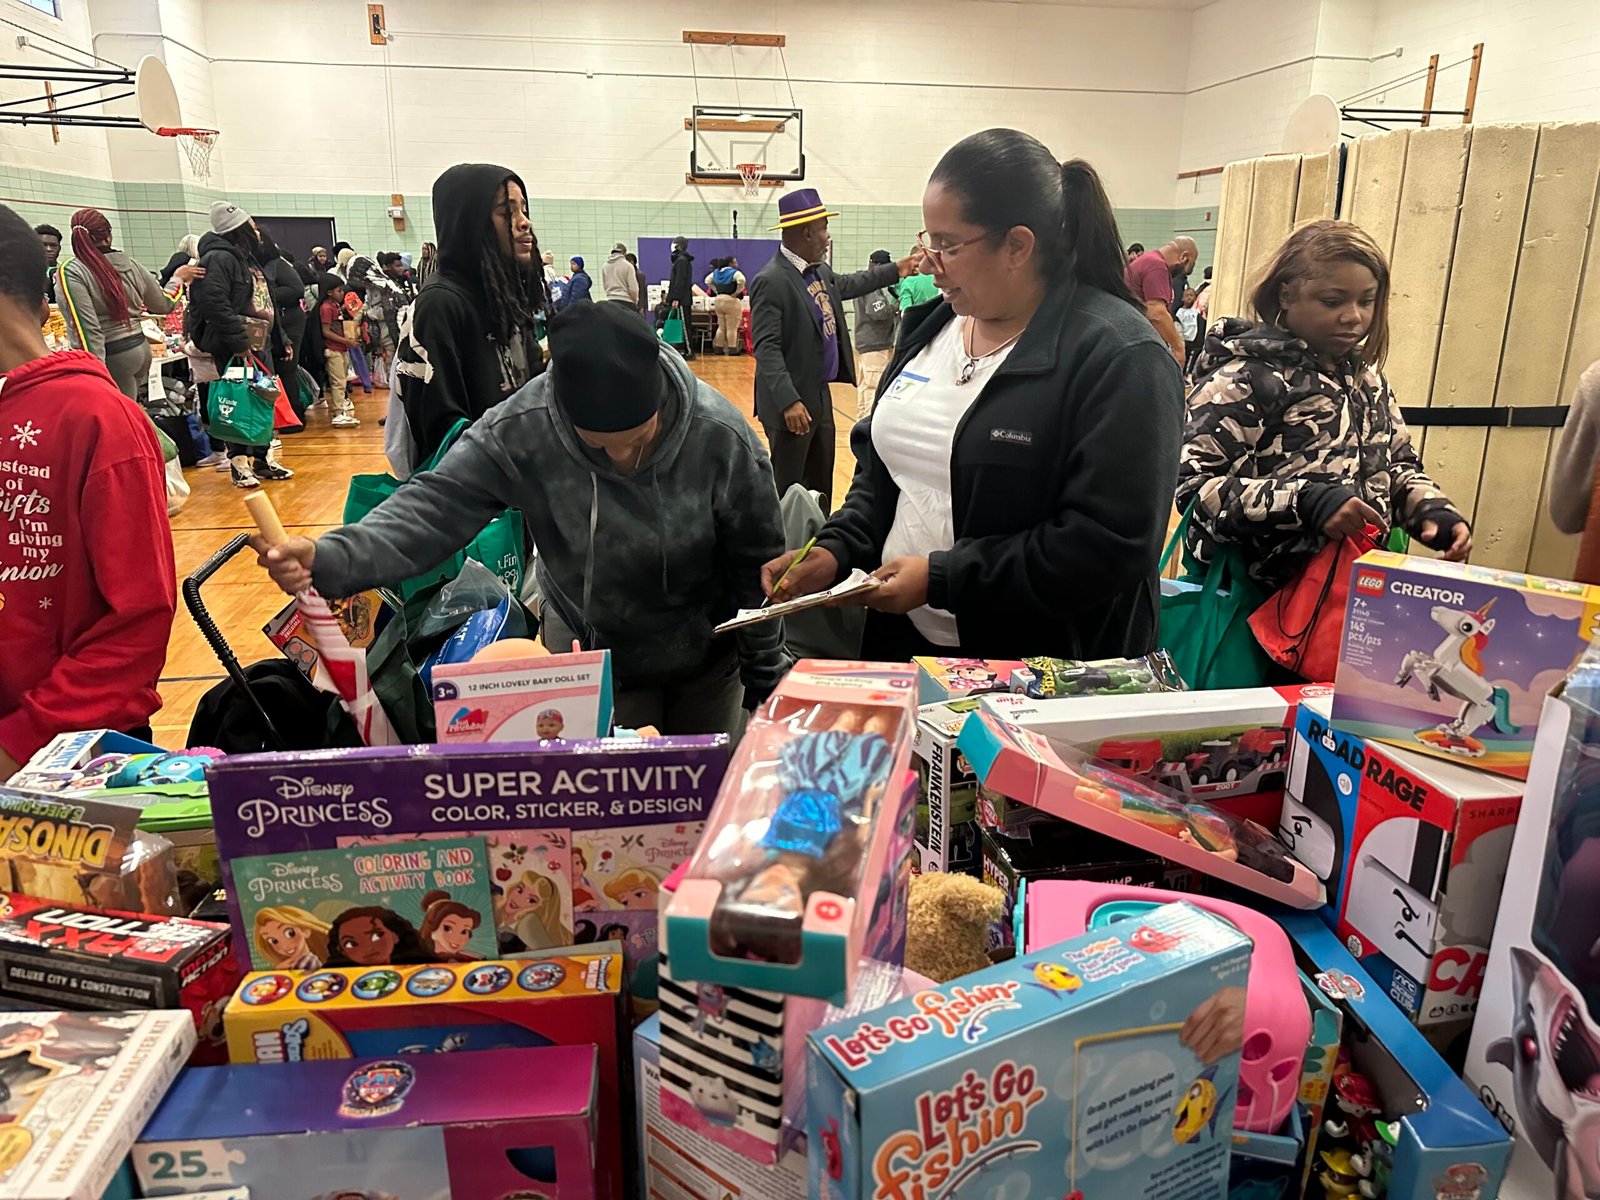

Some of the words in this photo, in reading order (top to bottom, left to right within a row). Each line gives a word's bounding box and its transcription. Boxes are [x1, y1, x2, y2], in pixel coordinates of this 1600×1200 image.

[1000, 430, 1031, 443] Columbia
[5, 478, 23, 491] of
[8, 531, 63, 546] giving
[19, 518, 48, 532] I'm
[23, 546, 49, 563] my
[1353, 597, 1367, 608] 7+
[1359, 576, 1382, 589] LEGO
[1390, 581, 1465, 605] CREATOR
[1348, 631, 1382, 646] pcs/pzs
[1350, 621, 1365, 632] 145
[480, 682, 499, 690] INCH
[501, 680, 530, 688] LOVELY
[532, 678, 552, 686] BABY
[554, 676, 574, 684] DOLL
[269, 775, 354, 802] Disney
[424, 771, 541, 800] SUPER
[551, 764, 707, 794] ACTIVITY
[1366, 760, 1428, 812] RAGE
[431, 805, 510, 823] COLOR,
[515, 802, 605, 820] STICKER,
[609, 800, 625, 815] &
[629, 798, 702, 815] DESIGN
[927, 741, 943, 855] FRANKENSTEIN
[237, 797, 392, 838] PRINCESS
[267, 862, 319, 878] Disney
[354, 850, 431, 875] COLORING
[436, 847, 473, 868] AND
[983, 854, 1009, 892] HYPER
[248, 874, 343, 902] PRINCESS
[360, 872, 426, 893] ACTIVITY
[435, 869, 475, 888] BOOK
[10, 967, 45, 983] DELUXE
[46, 972, 67, 986] CITY
[70, 977, 78, 988] &
[80, 980, 150, 1000] CONSTRUCTION
[1389, 987, 1413, 1011] CLUB
[825, 1025, 891, 1068] Let's
[887, 1016, 931, 1040] Go
[1108, 1093, 1127, 1108] your
[1128, 1080, 1156, 1097] fishing
[1157, 1072, 1175, 1087] pole
[918, 1072, 986, 1151] Let's
[993, 1062, 1034, 1103] Go
[1086, 1121, 1103, 1135] and
[1104, 1114, 1118, 1129] get
[1119, 1104, 1143, 1120] ready
[1154, 1090, 1173, 1104] cast
[1086, 1138, 1104, 1153] with
[1106, 1128, 1124, 1144] Let's
[1126, 1124, 1137, 1134] Go
[148, 1150, 207, 1179] 25
